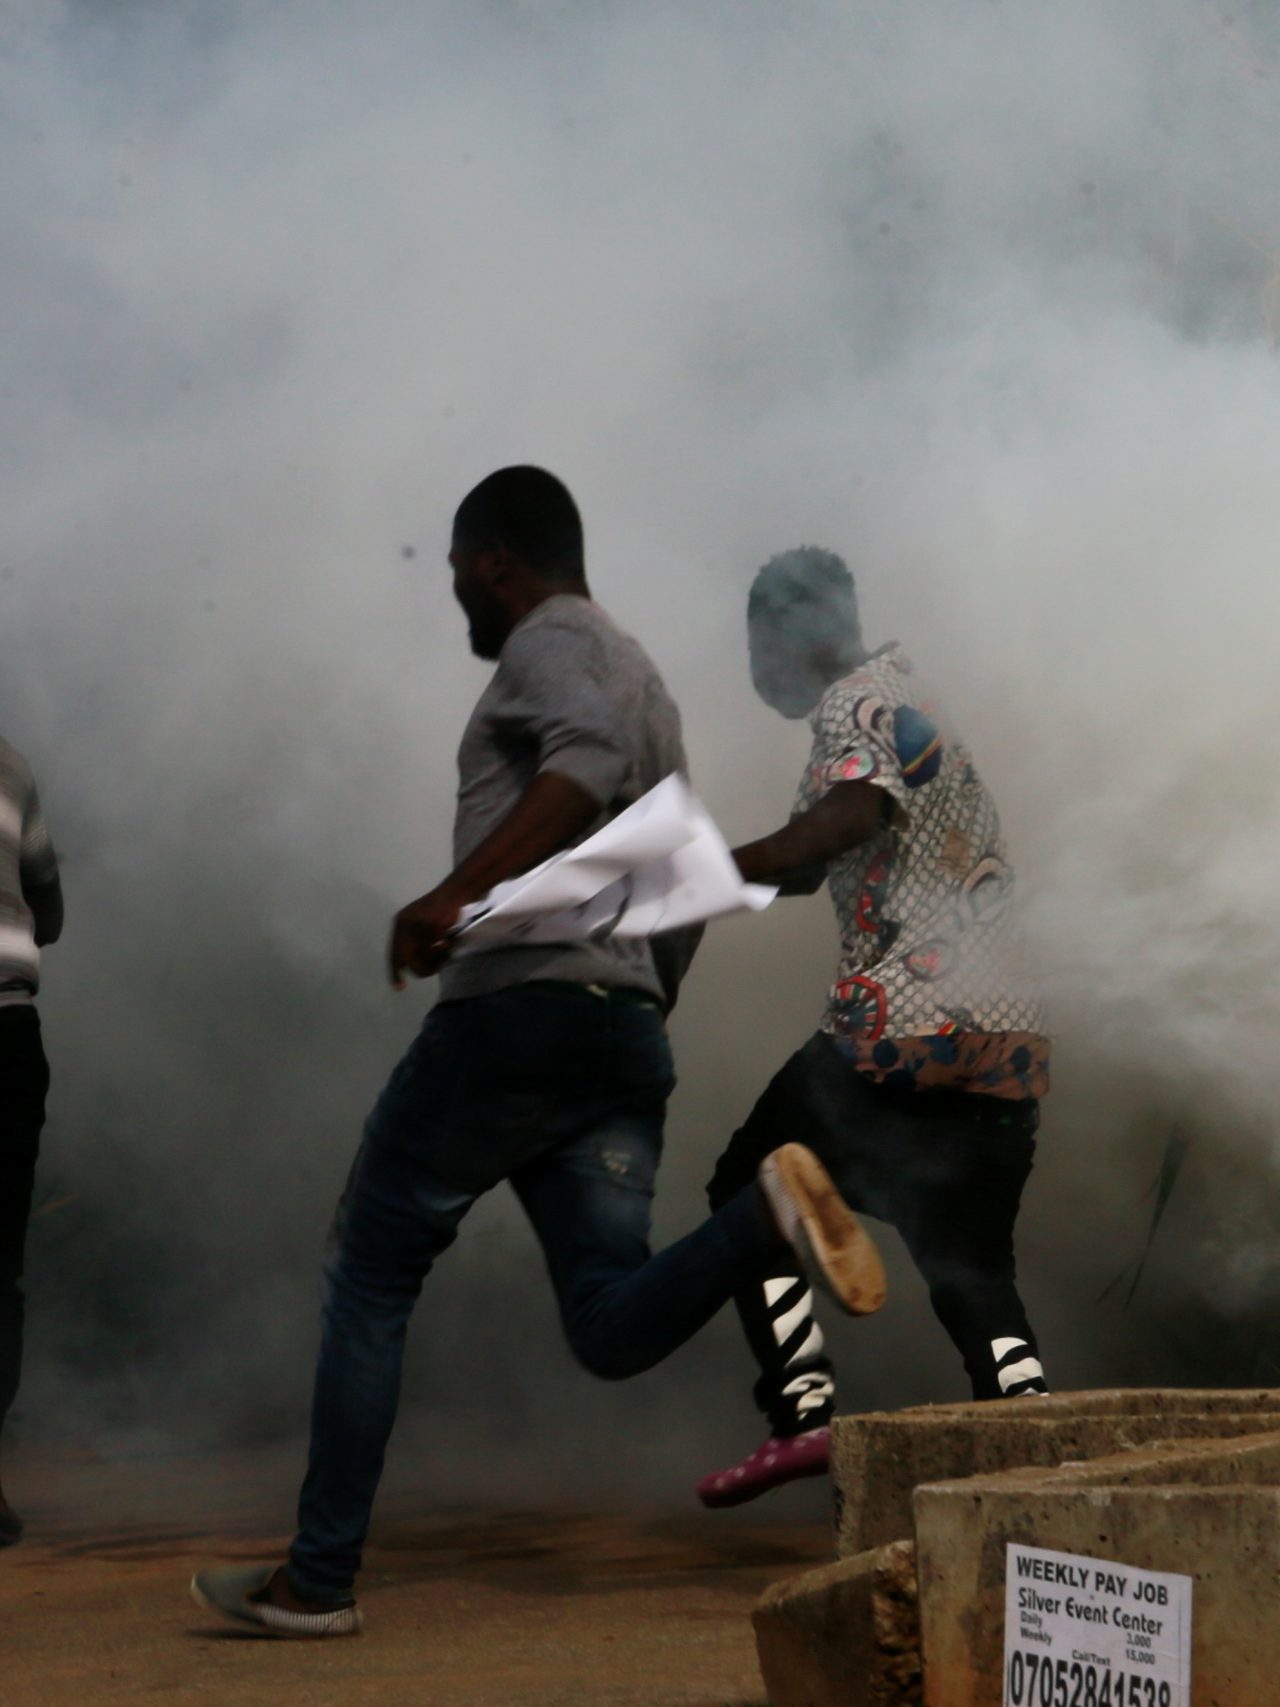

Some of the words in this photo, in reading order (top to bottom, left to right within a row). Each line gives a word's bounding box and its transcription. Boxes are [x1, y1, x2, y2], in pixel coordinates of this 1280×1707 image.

[1016, 1556, 1089, 1588] WEEKLY
[1095, 1571, 1127, 1597] PAY
[1133, 1581, 1169, 1606] JOB
[1018, 1587, 1061, 1614] Silver
[1065, 1597, 1108, 1625] Event
[1112, 1608, 1163, 1636] Center
[1020, 1611, 1043, 1628] Daily
[1020, 1627, 1052, 1647] Weekly
